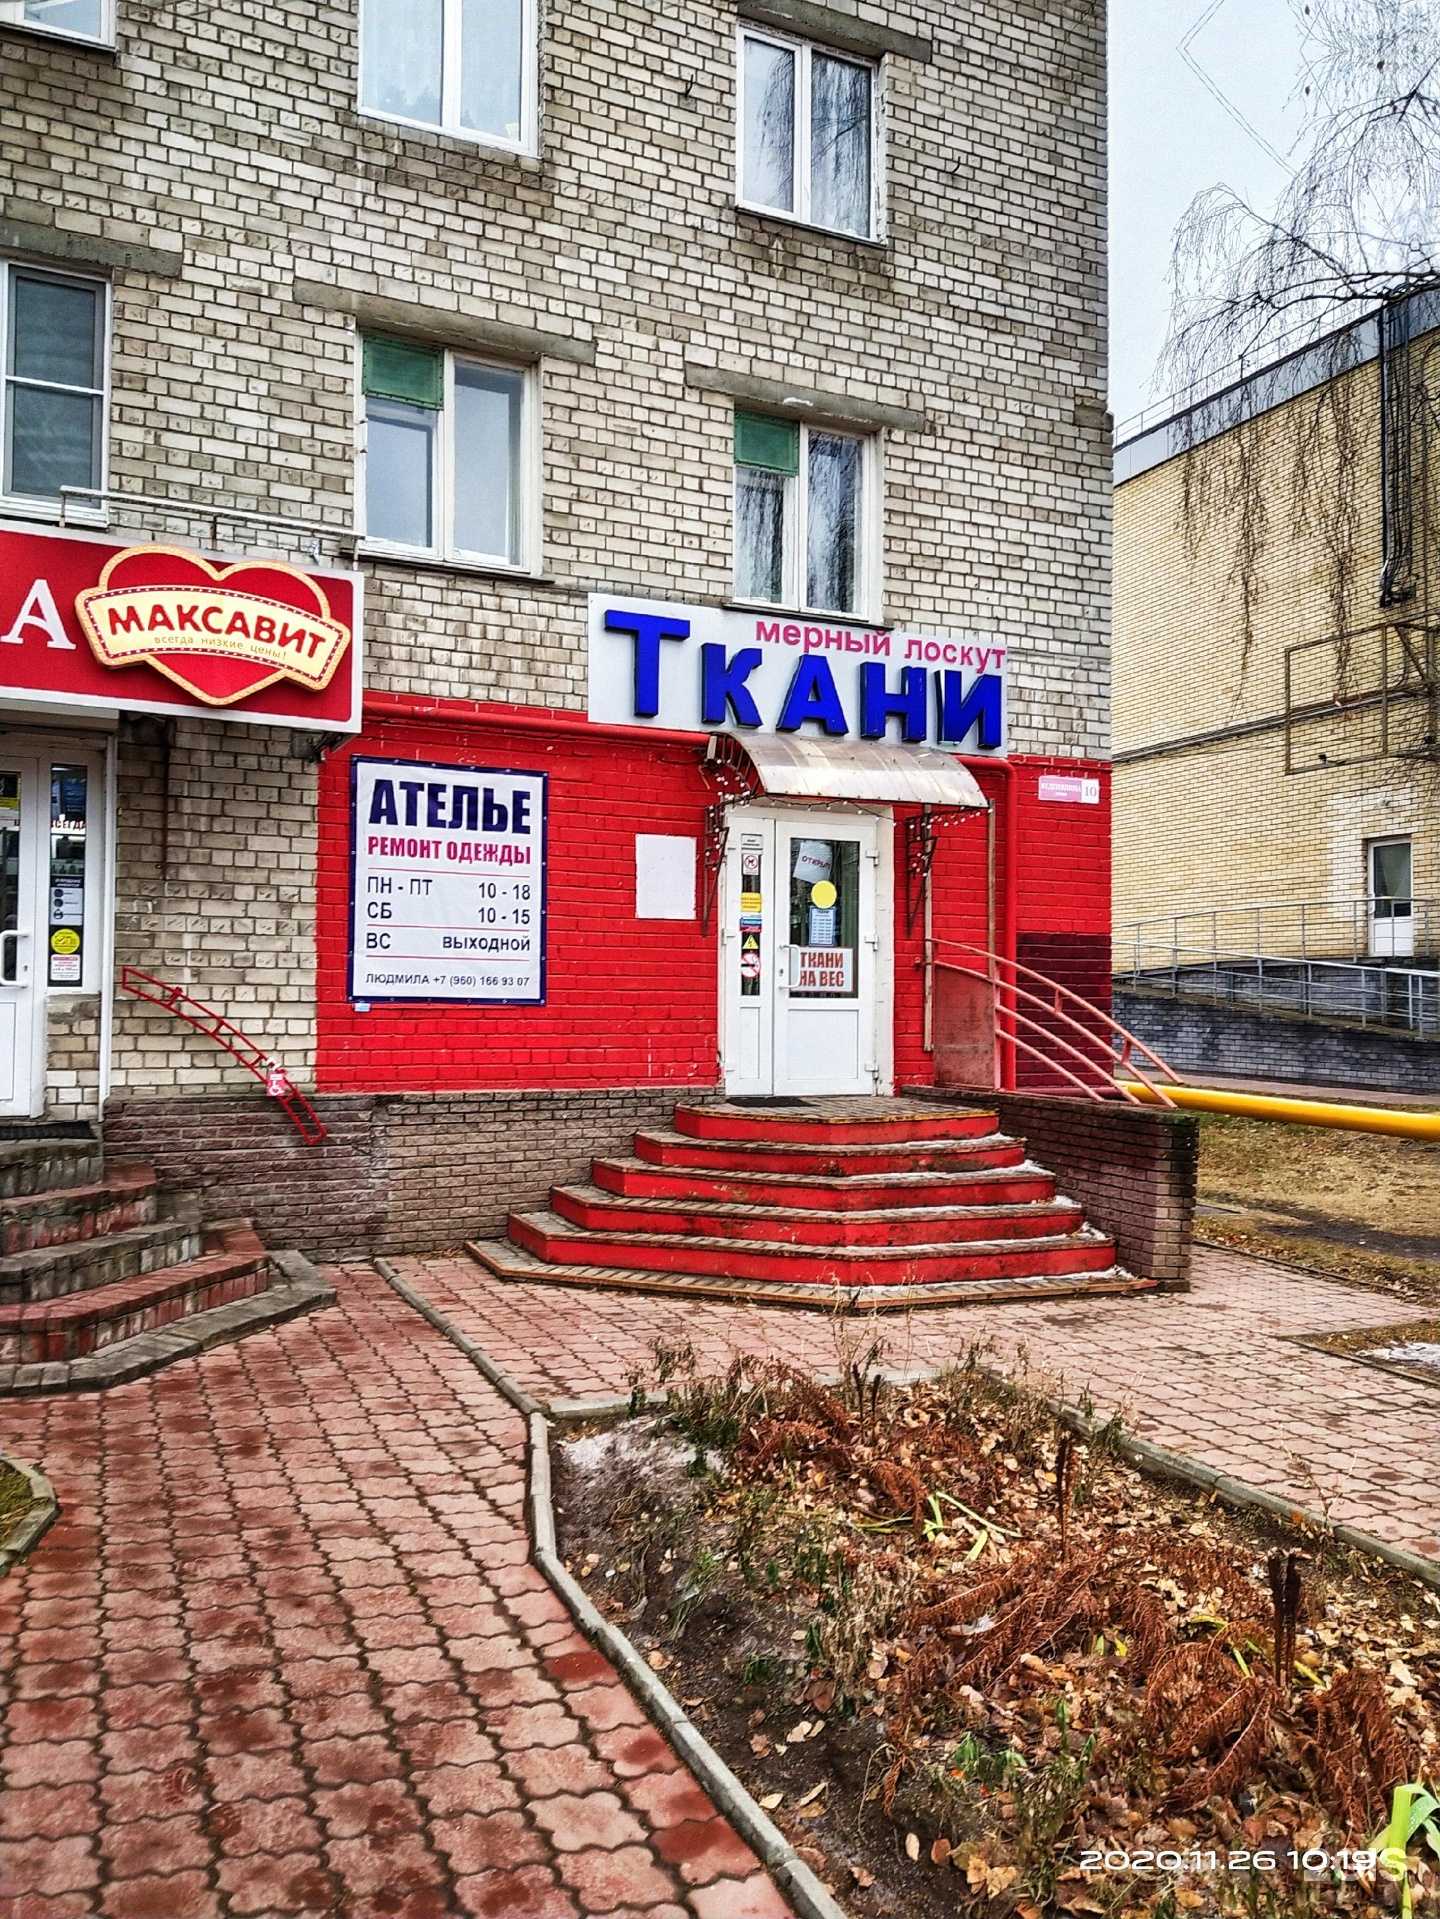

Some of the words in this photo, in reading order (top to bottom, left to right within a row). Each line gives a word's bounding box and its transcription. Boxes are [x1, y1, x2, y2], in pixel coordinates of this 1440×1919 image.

[108, 603, 326, 659] МАКСАВИТ
[153, 634, 194, 646] всегда
[201, 637, 244, 650] низкие
[250, 644, 287, 660] цены!
[755, 619, 891, 656] мерный
[904, 638, 1006, 674] лоскут
[604, 609, 1002, 749] ТКАНИ
[1084, 785, 1097, 797] 10
[368, 778, 531, 835] АТЕЛЬЕ
[368, 836, 442, 861] РЕМОНТ
[446, 841, 531, 867] ОДЕЖДЫ
[367, 876, 392, 894] ПН
[409, 878, 432, 896] ПТ
[478, 882, 496, 899] 10
[513, 884, 531, 900] 18
[367, 902, 392, 919] СБ
[478, 907, 496, 923] 10
[512, 909, 530, 924] 15
[366, 932, 391, 949] ВС
[442, 934, 530, 953] ВЫХОДНОЙ
[800, 951, 843, 968] ТКАНИ
[365, 973, 430, 986] ЛЮДМИЛА
[433, 976, 446, 985] +7
[449, 976, 476, 987] (960)
[501, 977, 514, 986] 93
[516, 977, 530, 986] 07
[800, 970, 816, 986] НА
[820, 971, 844, 987] ВЕС
